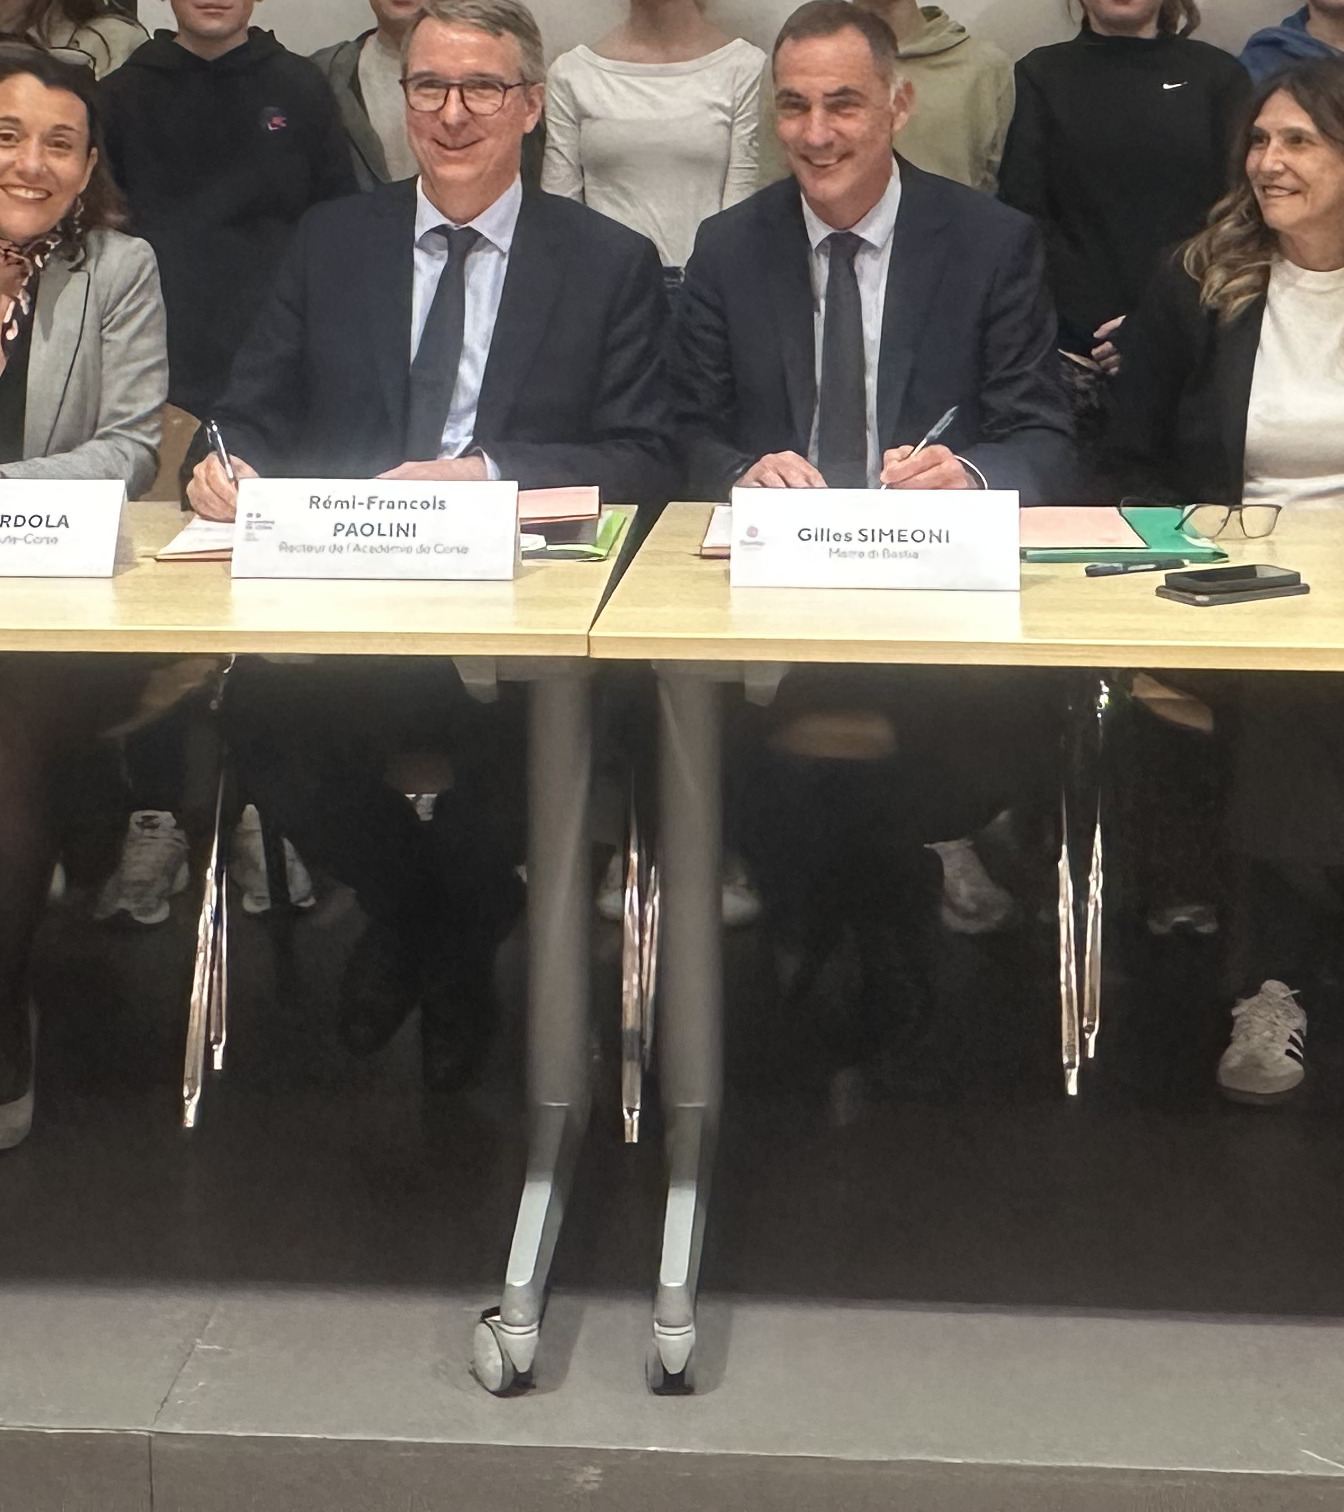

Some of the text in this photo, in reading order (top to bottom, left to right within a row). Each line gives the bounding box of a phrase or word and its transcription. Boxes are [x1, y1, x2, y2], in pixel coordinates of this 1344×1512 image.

[332, 522, 418, 538] PAOLINI
[797, 527, 951, 544] Gilles SIMEONI
